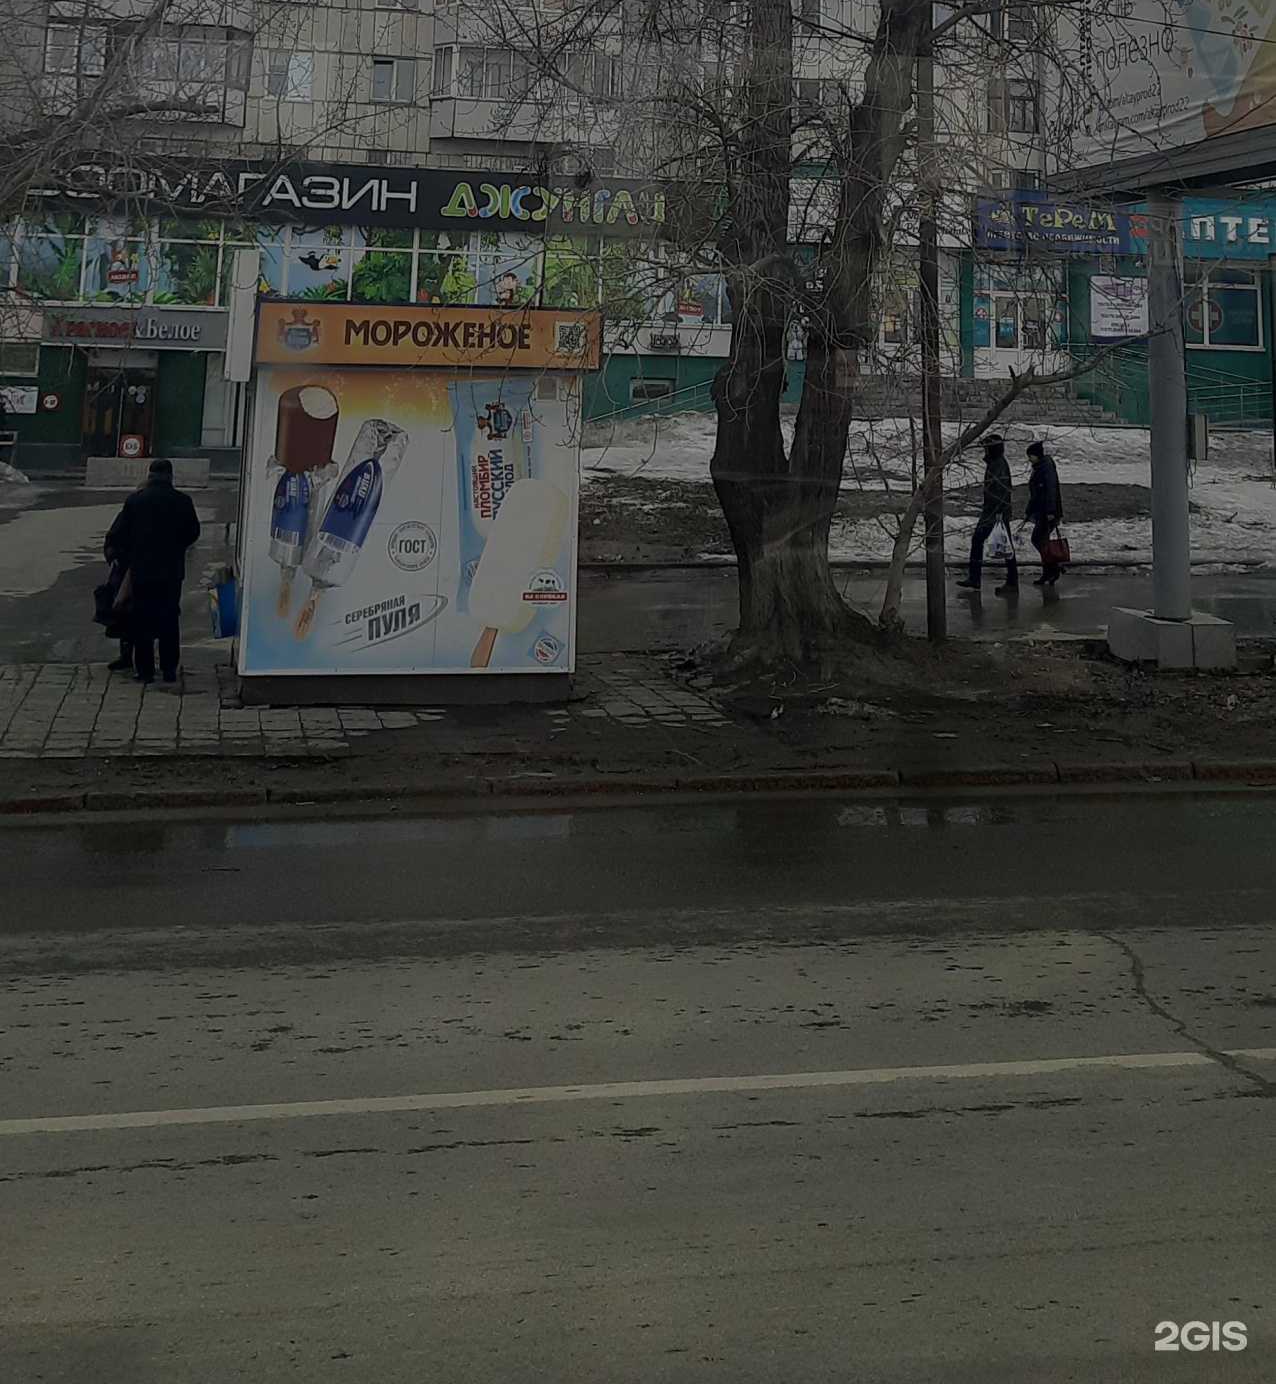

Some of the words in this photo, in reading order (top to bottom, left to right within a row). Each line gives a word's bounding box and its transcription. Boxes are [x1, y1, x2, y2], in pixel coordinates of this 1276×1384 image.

[28, 164, 418, 214] ООМАГАЗИН
[146, 317, 201, 341] Белое
[344, 318, 531, 350] МОРОЖЕНОЕ
[478, 455, 491, 519] ПЛОМБИР
[488, 449, 505, 520] УССКИЙ
[399, 539, 426, 554] ГОСТ
[345, 595, 405, 625] СЕРЕБРЯНАЯ
[368, 603, 420, 641] ПУЛЯ
